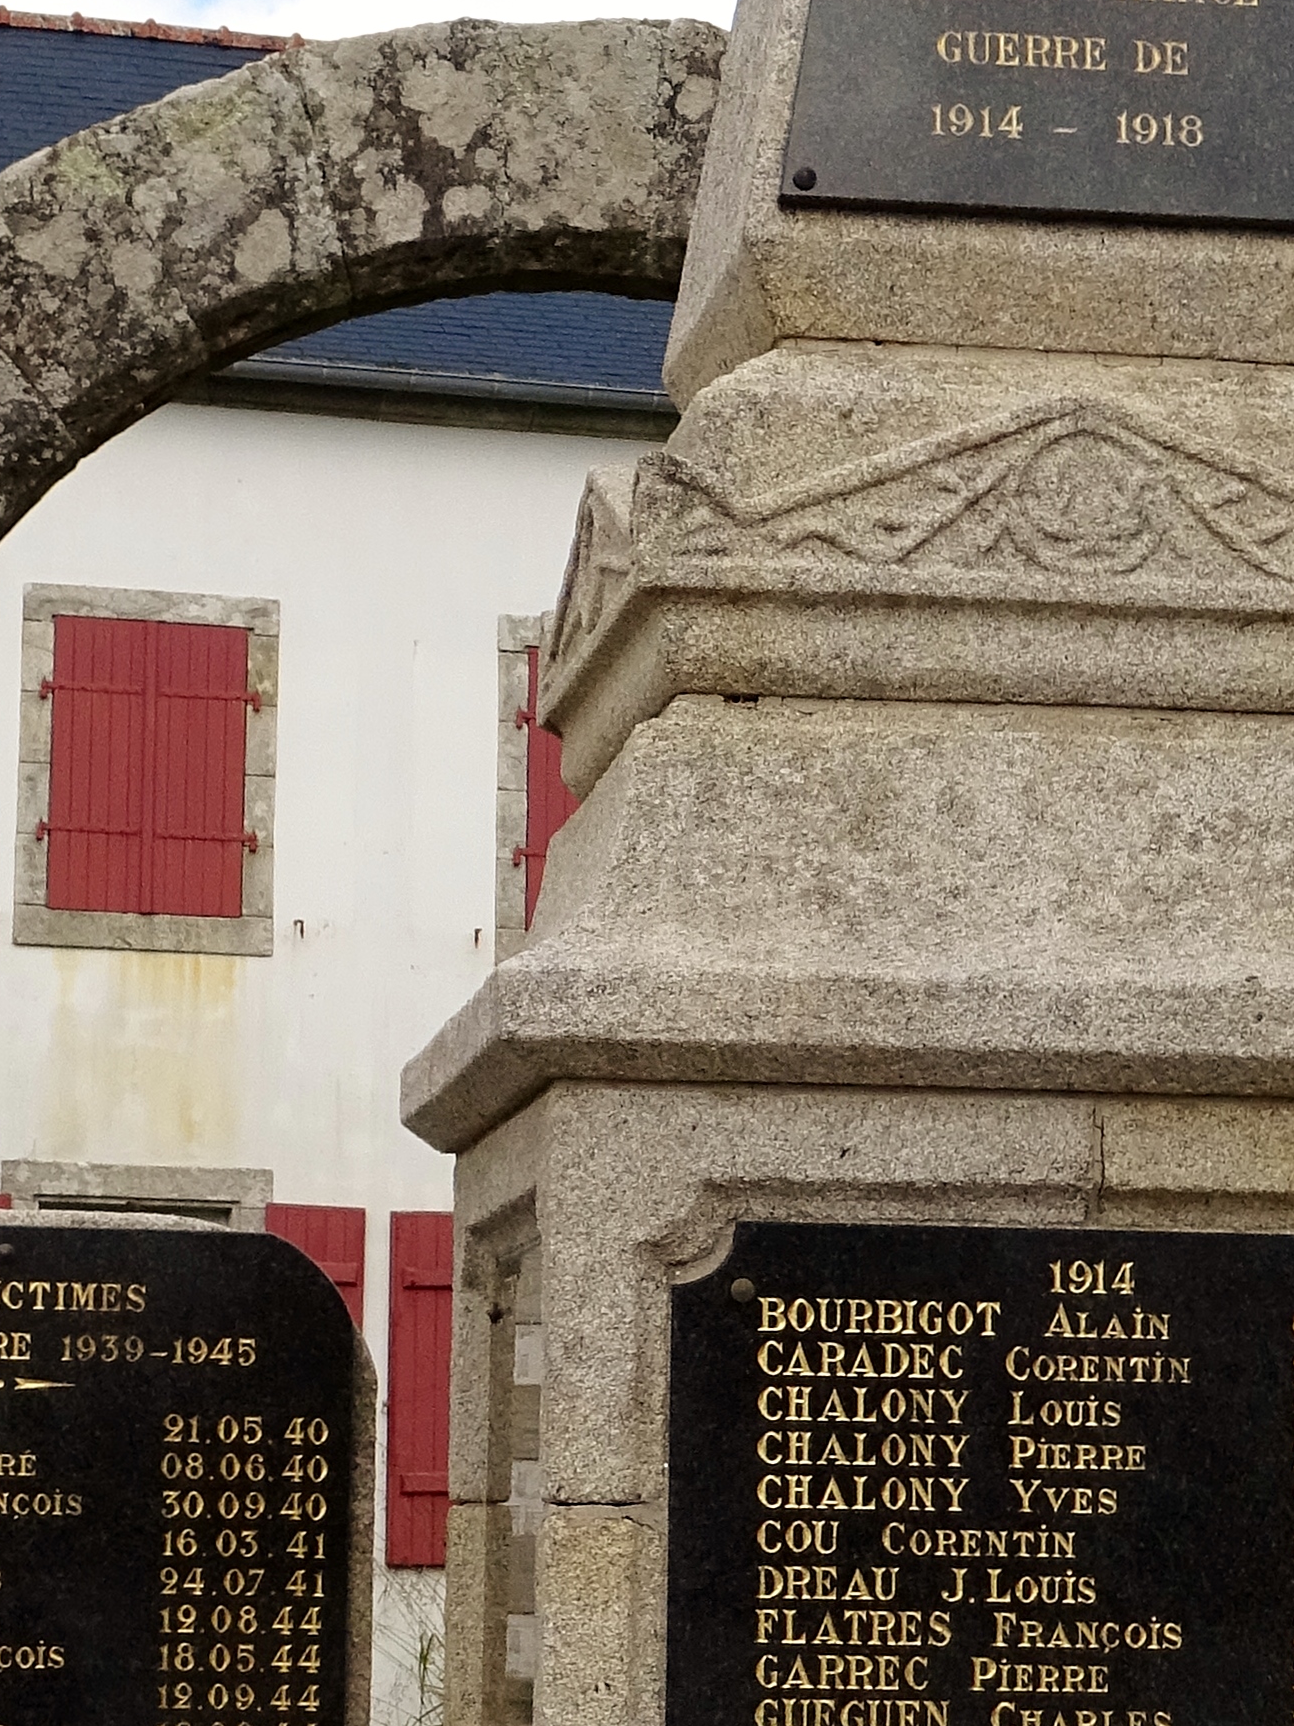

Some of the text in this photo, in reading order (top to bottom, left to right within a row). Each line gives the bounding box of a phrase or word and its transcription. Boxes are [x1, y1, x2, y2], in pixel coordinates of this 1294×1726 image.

[937, 31, 1188, 75] GUERRE DE
[932, 104, 1023, 139] 1914
[1117, 110, 1204, 147] 1918
[1050, 1260, 1135, 1295] 1914
[758, 1297, 1001, 1336] BOURBIGOT
[757, 1340, 963, 1379] CARADEC
[758, 1386, 968, 1424] CHALONY
[757, 1431, 969, 1467] CHALONY
[757, 1474, 969, 1512] CHALONY
[757, 1520, 839, 1554] COU
[757, 1565, 899, 1601] DREAU
[756, 1609, 951, 1647] FLATRES
[756, 1654, 928, 1690] GARREC
